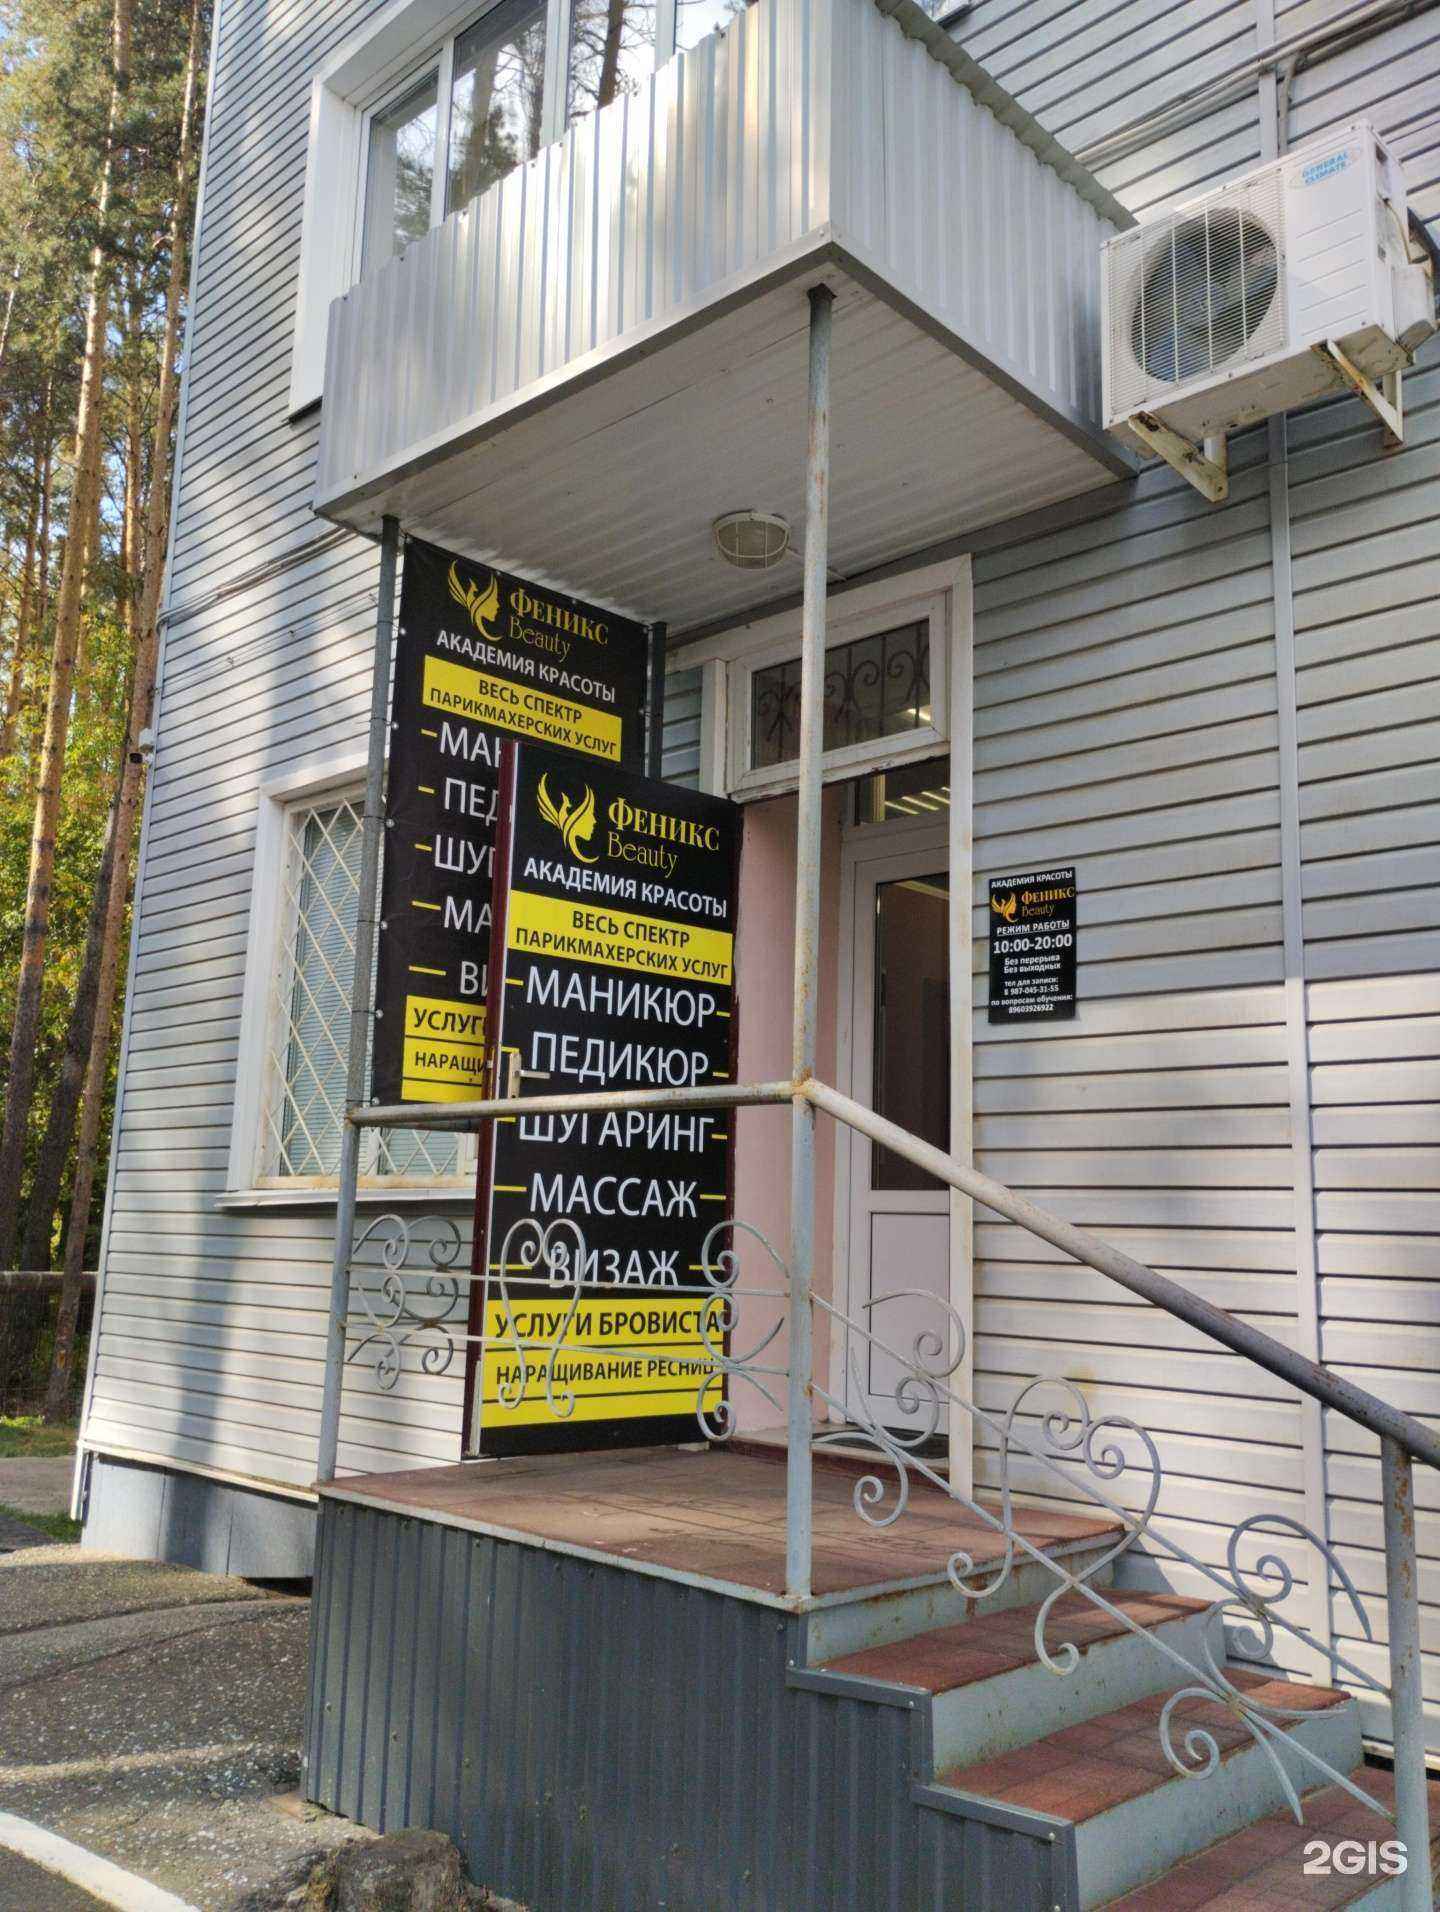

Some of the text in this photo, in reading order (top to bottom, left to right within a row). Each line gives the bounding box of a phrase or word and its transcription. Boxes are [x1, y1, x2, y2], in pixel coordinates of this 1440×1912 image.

[510, 587, 609, 646] ФЕНИКС
[510, 615, 571, 662] Beauty
[436, 630, 615, 703] АКАДЕМИЯ КРАСОТЫ
[430, 687, 617, 756] ПАРИКМАХЕРСКИХ УСЛУГ
[479, 679, 582, 724] ВЕСЬ СПЕКТР
[608, 797, 720, 851] ФЕНИКС
[607, 831, 679, 878] Beauty
[524, 858, 727, 918] АКАДЕМИЯ КРАСОТЫ
[991, 870, 1073, 888] АКАДЕМИЯ КРАСОТЫ
[1021, 887, 1075, 904] ФЕНИКС
[572, 910, 690, 948] ВЕСЬ СПЕКТР
[996, 919, 1070, 936] РЕЖИМ РАБОТЫ
[1022, 903, 1055, 917] Beauty
[516, 928, 728, 979] ПАРИКМАХЕРСКИХ УСЛУГ
[993, 934, 1072, 954] 10:00-20:00
[1004, 954, 1060, 966] Без перерыва
[1003, 963, 1061, 974] Без выходных
[526, 966, 715, 1028] МАНИКЮР
[531, 1031, 709, 1087] ПЕДИКЮР
[530, 1172, 697, 1218] МАССАЖ
[598, 1311, 720, 1336] БРОВИСТА
[497, 1360, 642, 1385] НАРАЩИВАНИЕ
